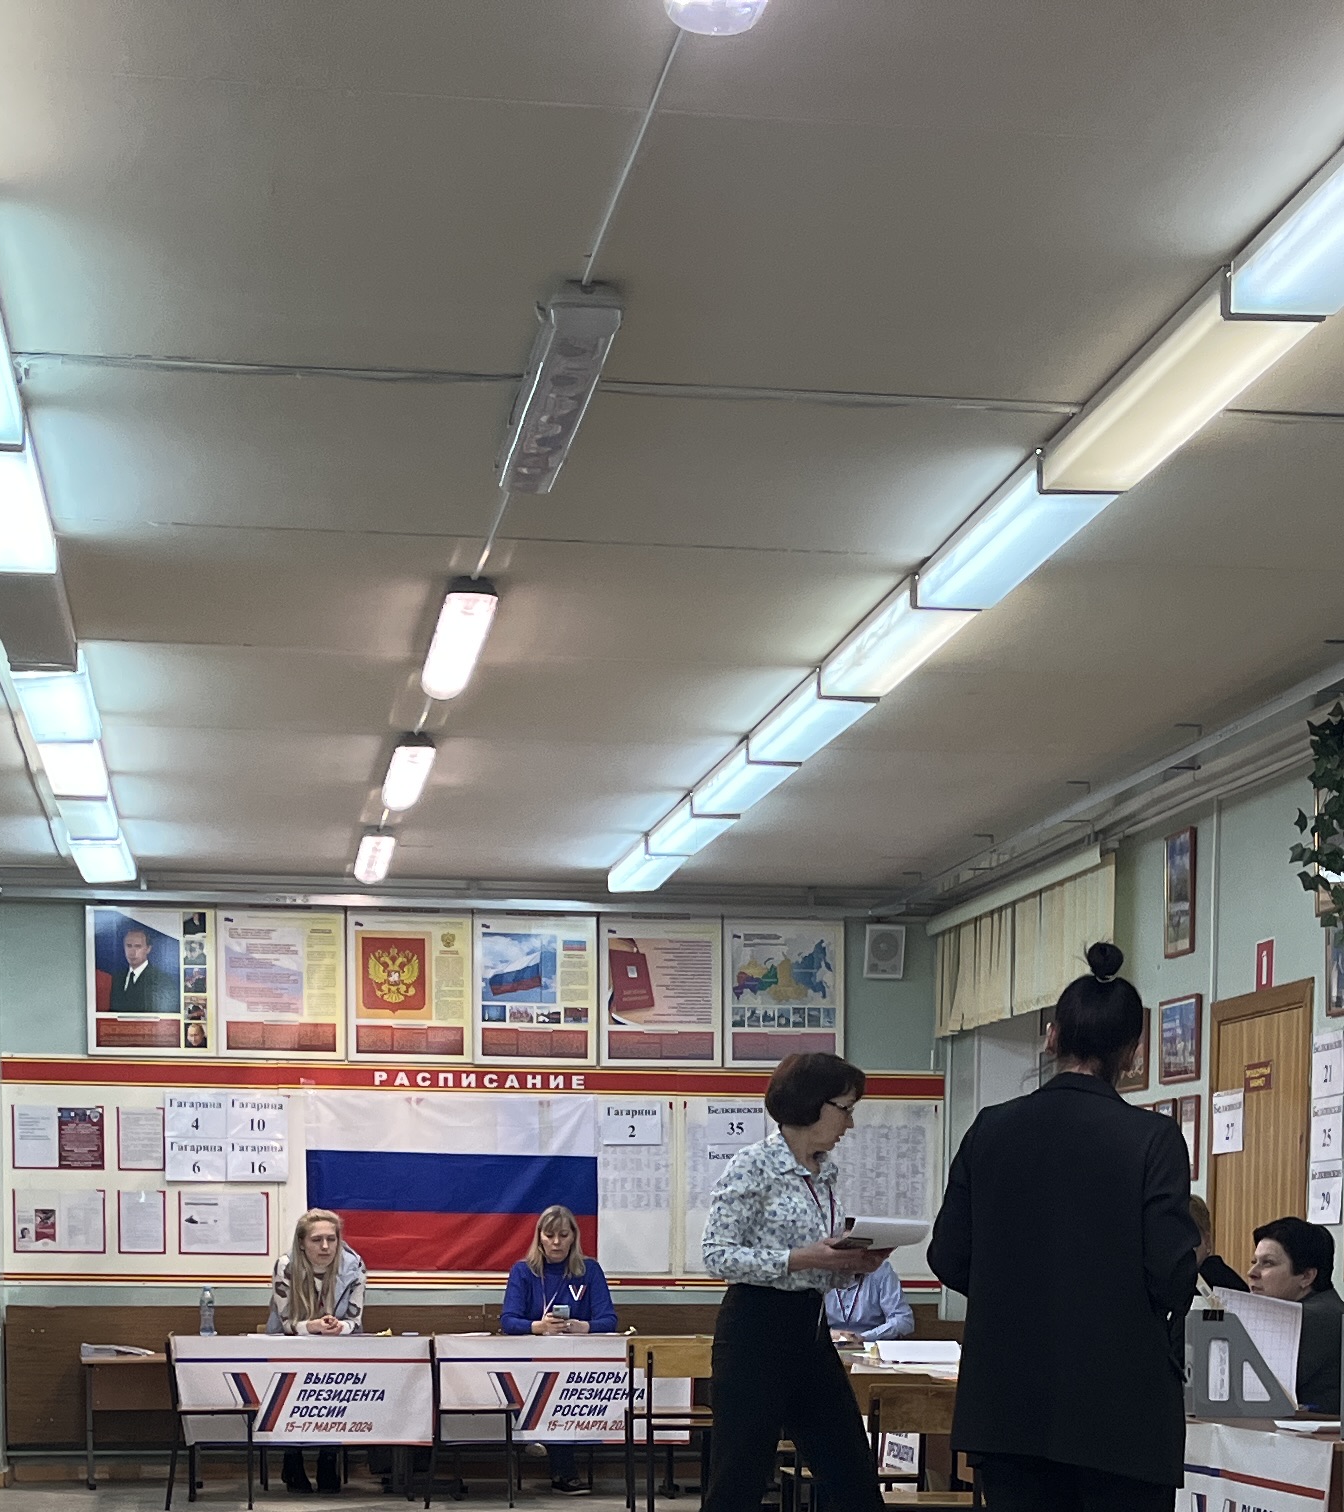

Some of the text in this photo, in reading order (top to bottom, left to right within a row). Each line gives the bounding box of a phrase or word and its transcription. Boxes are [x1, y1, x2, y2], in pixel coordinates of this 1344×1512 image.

[1323, 1064, 1332, 1083] 21
[373, 1071, 586, 1090] РАСПИСАНИЕ
[169, 1098, 223, 1111] Гагарина
[231, 1098, 284, 1112] Гагарина
[607, 1106, 657, 1119] Гагарина
[190, 1117, 200, 1131] 4
[249, 1117, 266, 1131] 10
[726, 1122, 745, 1136] 35
[628, 1124, 637, 1138] 2
[1322, 1128, 1331, 1147] 25
[170, 1142, 223, 1154] Гагарина
[231, 1142, 284, 1155] Гагарина
[192, 1161, 201, 1174] 6
[250, 1161, 267, 1174] 16
[1321, 1191, 1331, 1210] 29
[303, 1372, 367, 1384] ВЫБОРЫ
[566, 1371, 628, 1384] ВЫБОРЫ
[296, 1389, 385, 1403] ПРЕЗИДЕНТА
[289, 1406, 347, 1418] РОССИИ
[552, 1404, 608, 1417] РОССИИ
[312, 1421, 347, 1432] МАРТА
[348, 1421, 373, 1432] 2024
[575, 1420, 608, 1431] МАРТА
[609, 1420, 626, 1431] 202
